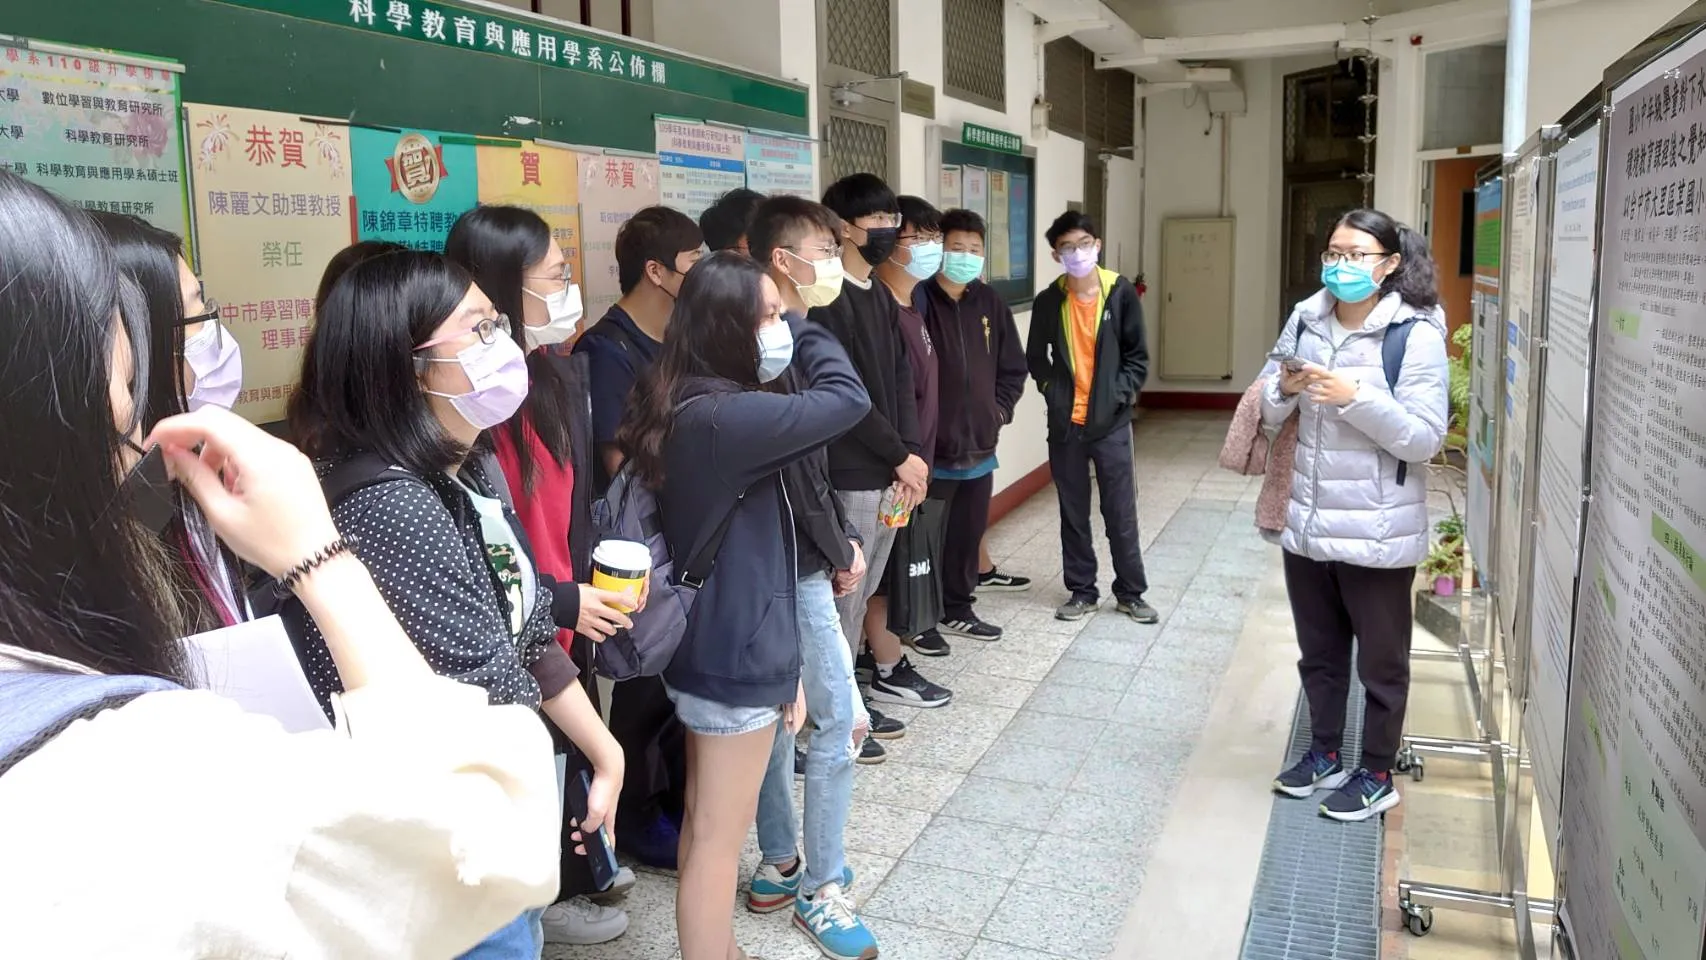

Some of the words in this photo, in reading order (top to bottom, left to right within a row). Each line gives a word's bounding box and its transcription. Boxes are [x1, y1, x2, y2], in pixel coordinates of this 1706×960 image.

[349, 0, 666, 84] 科學教育與應用學系公佈欄
[42, 91, 162, 116] 數位學習與教育研究所
[65, 128, 149, 148] 科學教育研究所
[245, 124, 307, 168] 恭賀
[36, 163, 179, 182] 科學教育與應用學系碩士班
[520, 151, 541, 186] 賀
[605, 160, 635, 188] 恭賀
[208, 191, 341, 217] 陳麗文助理教授
[263, 241, 303, 267] 榮任
[220, 298, 315, 324] 中市學習障
